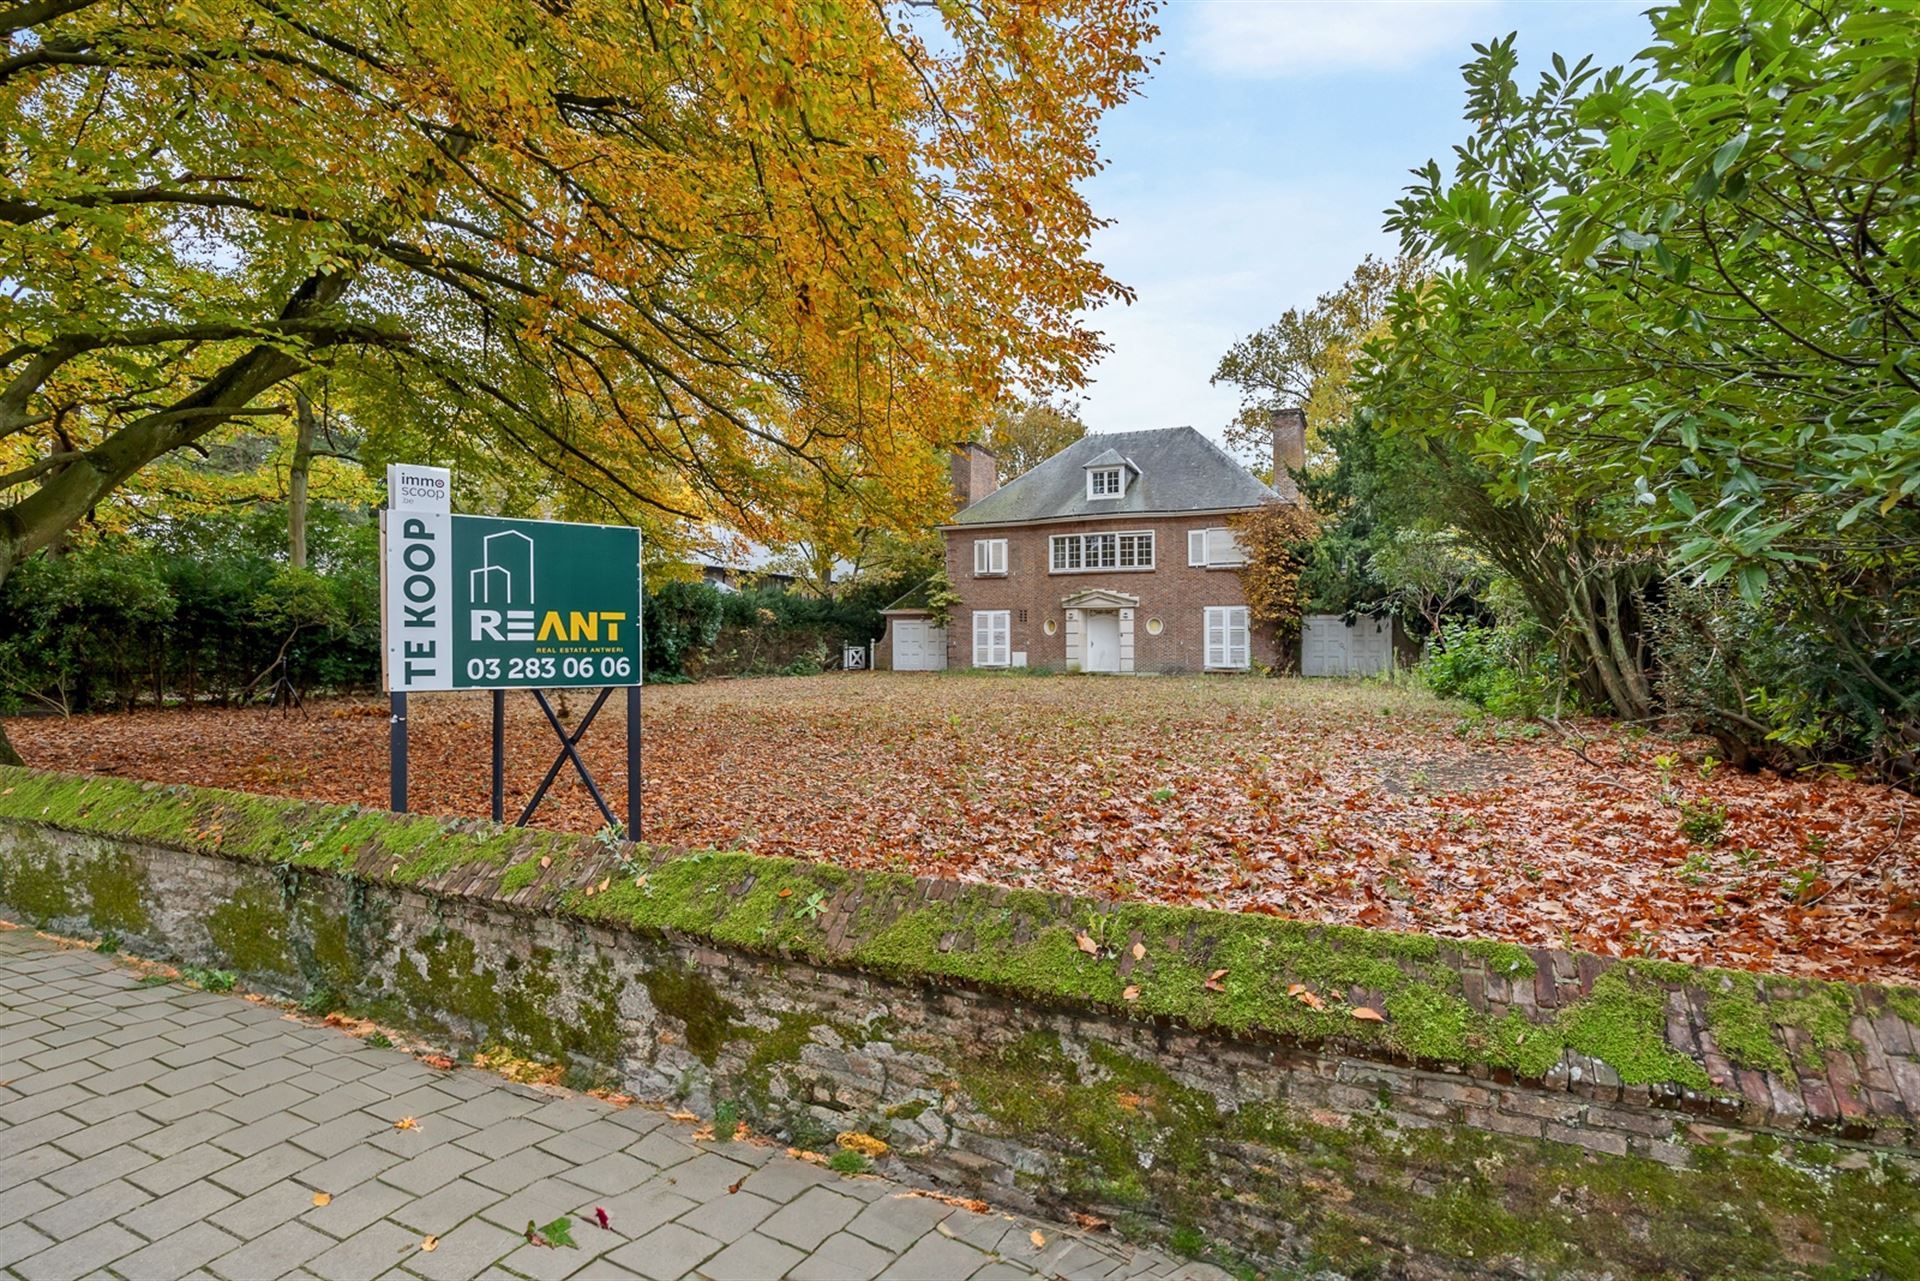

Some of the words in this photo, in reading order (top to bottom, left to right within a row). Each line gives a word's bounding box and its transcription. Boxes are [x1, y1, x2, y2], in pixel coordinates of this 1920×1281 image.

[401, 472, 445, 488] immo
[401, 486, 445, 500] scoop
[403, 518, 436, 628] KOOP
[470, 609, 626, 641] REANT
[404, 640, 436, 685] TE
[467, 658, 501, 680] 03
[508, 657, 556, 679] 283
[563, 657, 594, 678] 06
[600, 656, 631, 677] 06
